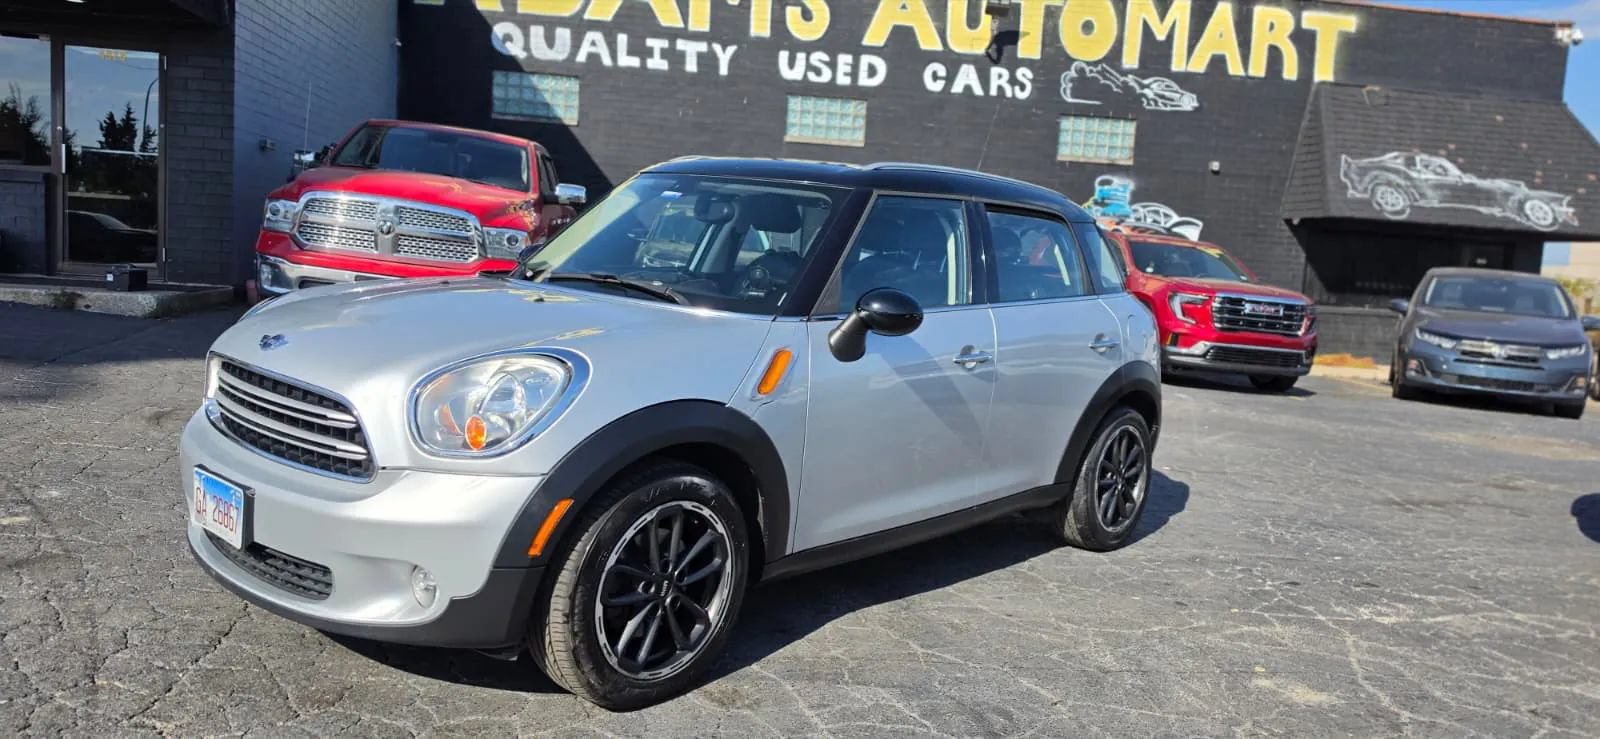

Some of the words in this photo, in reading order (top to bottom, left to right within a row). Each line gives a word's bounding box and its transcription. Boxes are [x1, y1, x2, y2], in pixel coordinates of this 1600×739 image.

[413, 0, 830, 41] AMS
[861, 0, 1357, 82] AUTOMART
[491, 22, 737, 75] QUALITY
[778, 50, 887, 87] USED
[923, 62, 1034, 100] CARS
